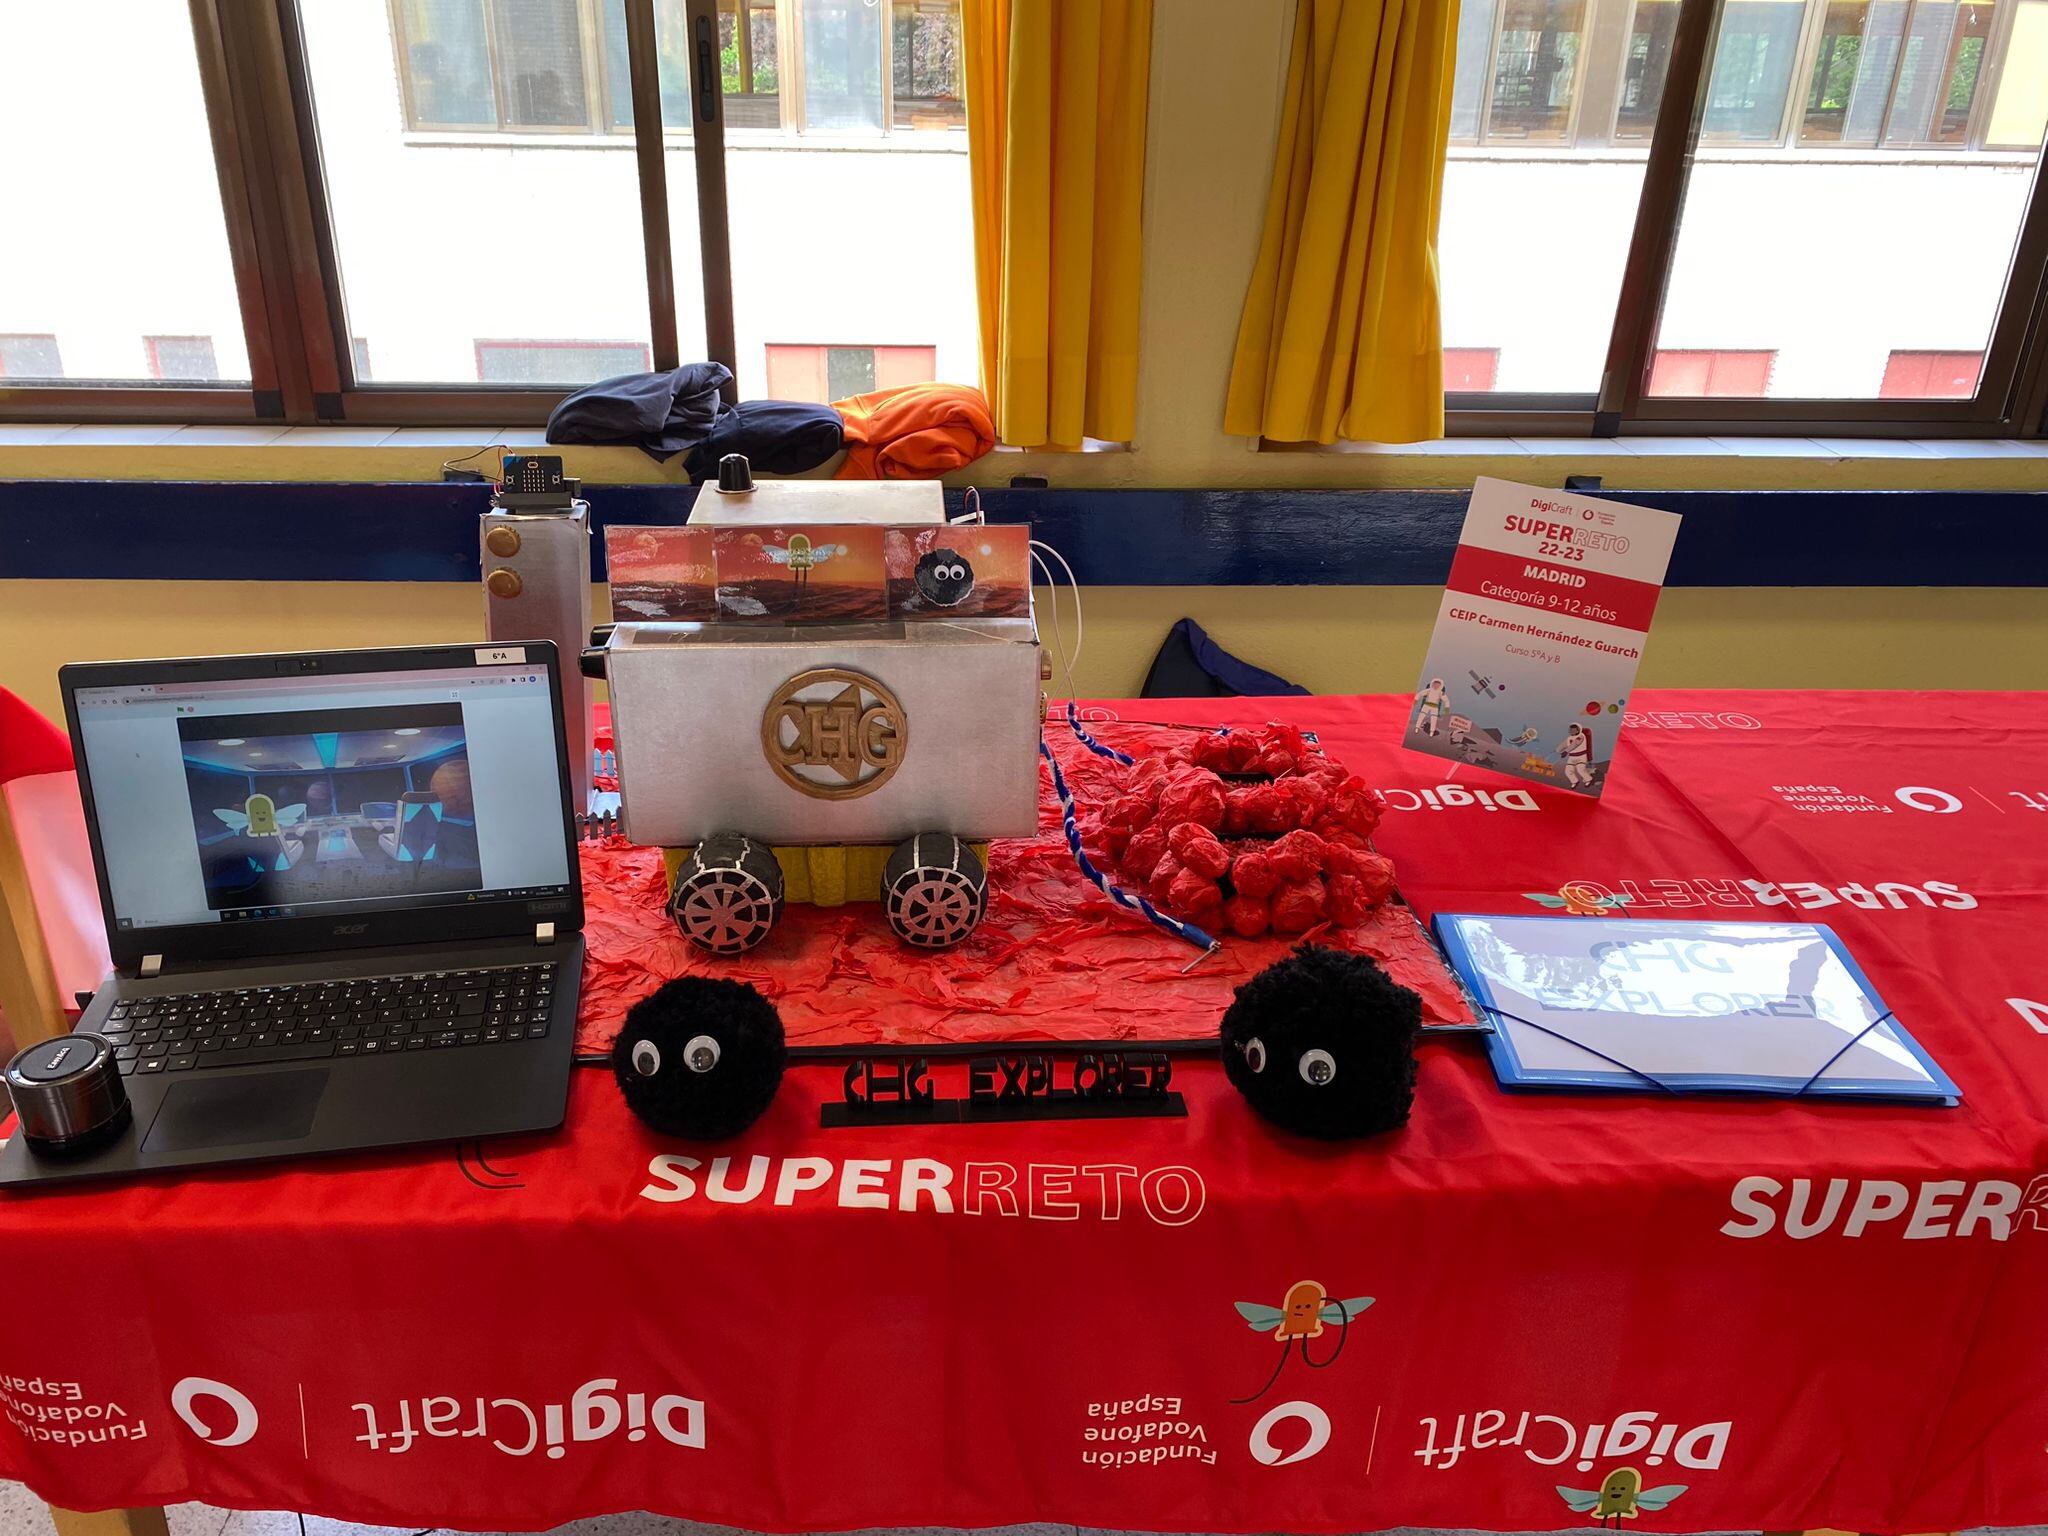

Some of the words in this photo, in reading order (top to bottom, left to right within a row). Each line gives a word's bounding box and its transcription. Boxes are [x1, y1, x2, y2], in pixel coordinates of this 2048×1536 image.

[1531, 499, 1573, 515] DigiCraft
[1504, 515, 1630, 554] SUPERRETO
[1538, 542, 1585, 562] 22-23
[1523, 565, 1587, 588] MADRID
[1480, 580, 1546, 606] Categoría
[1549, 595, 1580, 613] 9-12
[1583, 605, 1617, 621] años
[1449, 608, 1477, 621] CEIP
[1478, 615, 1524, 632] Carmen
[1526, 625, 1593, 649] Hernández
[1594, 641, 1639, 659] Guarch
[1505, 644, 1530, 657] Curso
[766, 703, 900, 767] CHG
[1771, 785, 1842, 795] España
[1792, 804, 1894, 815] Fundación
[333, 923, 369, 935] acer
[1589, 940, 1735, 974] CHG
[1533, 988, 1843, 1020] EXPLORER
[842, 1055, 935, 1107] CHG
[969, 1053, 1173, 1105] EXPLORER
[638, 1153, 1206, 1227] SUPERRETO
[351, 1378, 706, 1460] DigiCraft
[1087, 1393, 1182, 1420] España
[1084, 1421, 1208, 1443] Vodafone
[1414, 1409, 1733, 1473] DigiCraft
[1082, 1444, 1217, 1468] Fundación
